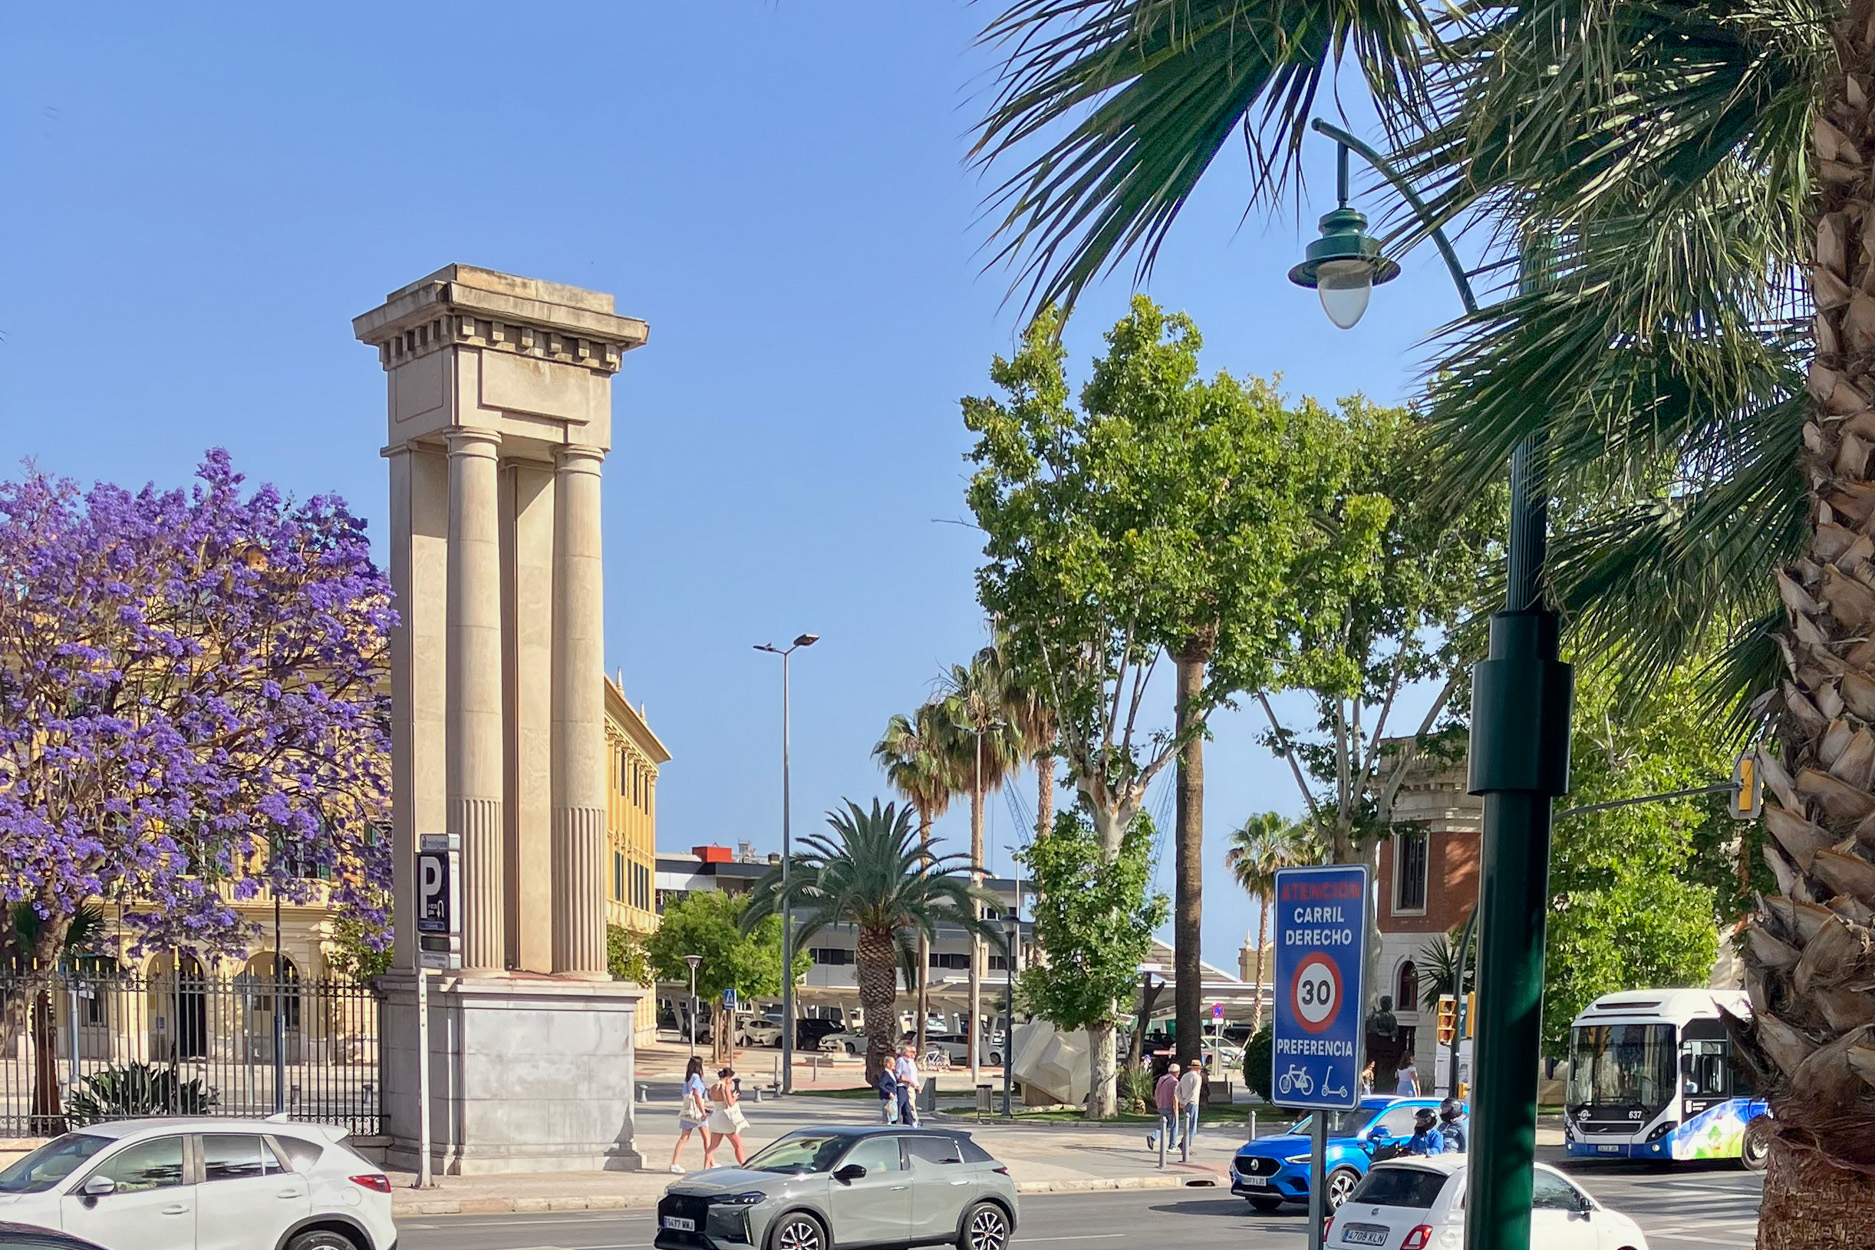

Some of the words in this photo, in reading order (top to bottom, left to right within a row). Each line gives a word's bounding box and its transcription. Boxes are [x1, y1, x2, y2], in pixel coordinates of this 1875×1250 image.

[420, 856, 442, 919] P
[1282, 880, 1361, 901] ATENCIÓN
[1294, 906, 1345, 923] CARRIL
[1285, 929, 1352, 945] DERECHO
[1302, 980, 1331, 1005] 30
[1277, 1038, 1353, 1057] PREFERENCIA
[1628, 1111, 1643, 1119] 637
